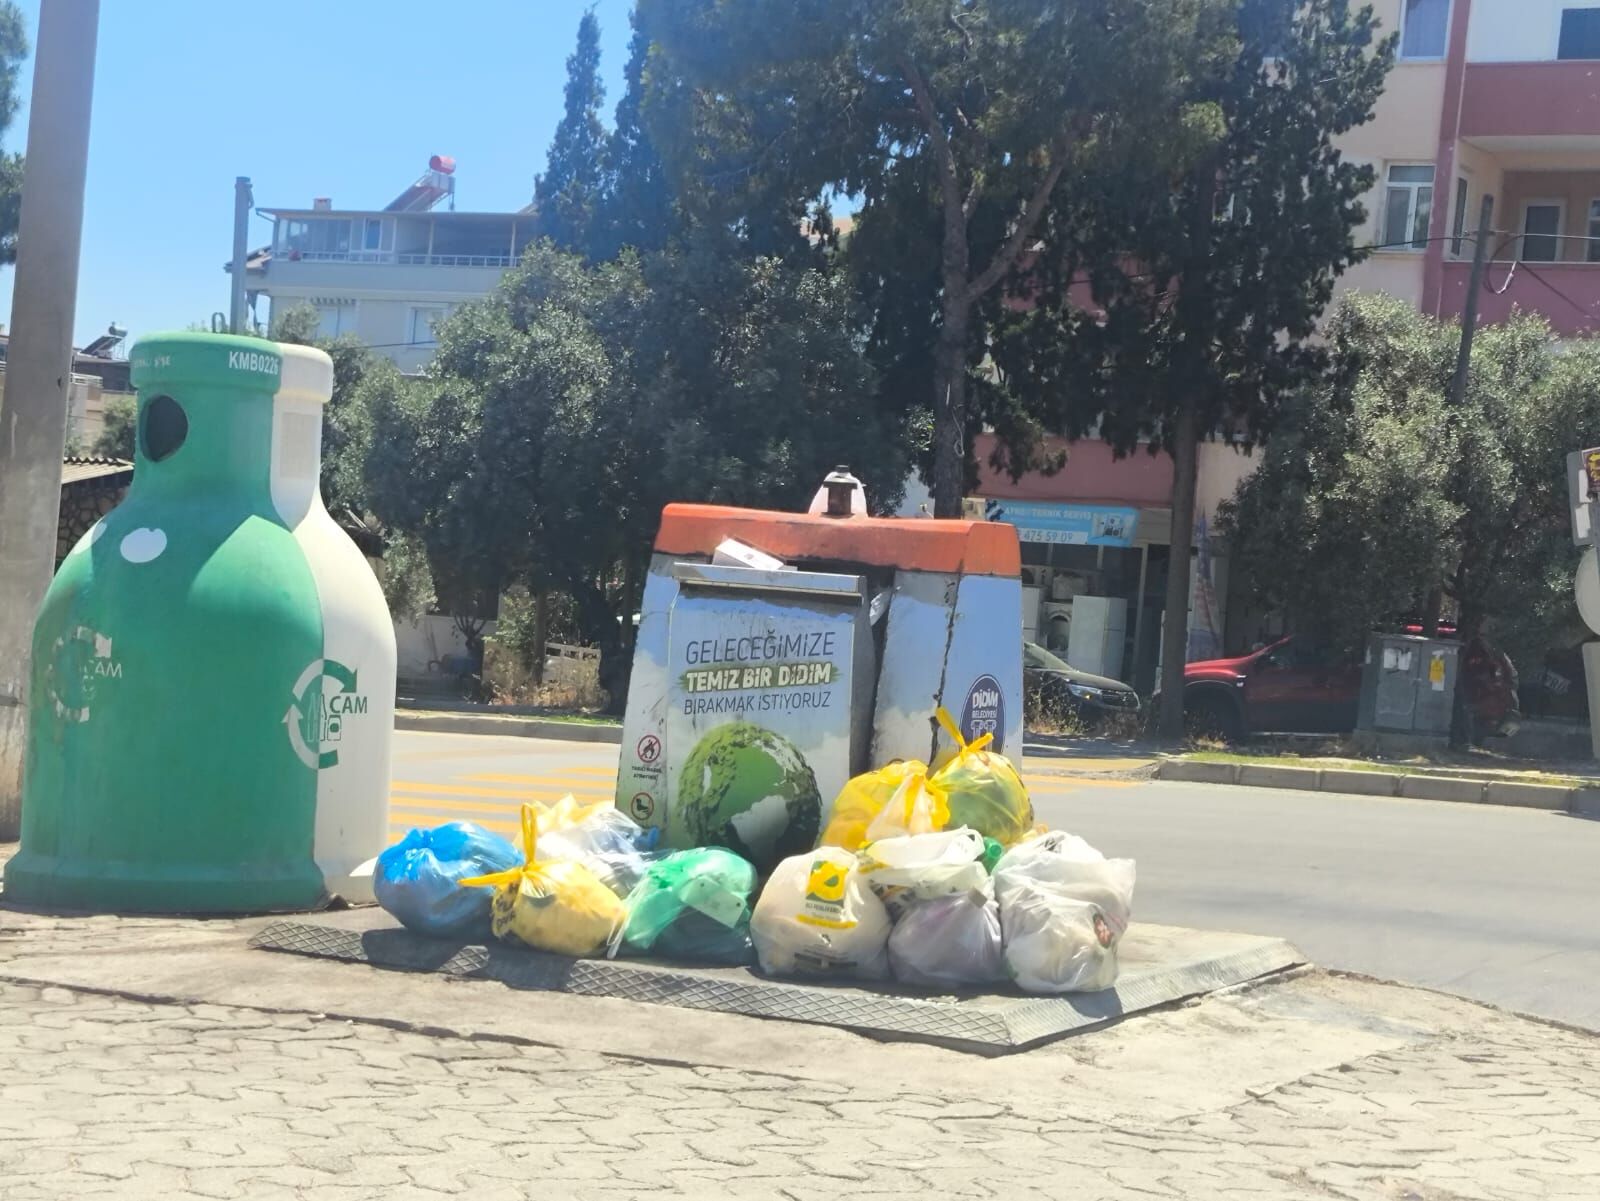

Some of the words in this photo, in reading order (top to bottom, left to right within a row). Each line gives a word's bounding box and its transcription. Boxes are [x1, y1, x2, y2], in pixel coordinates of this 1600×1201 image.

[228, 351, 279, 375] KMB0226
[1046, 531, 1058, 543] 59
[686, 629, 835, 664] GELECEĞİMİZE
[686, 668, 740, 693] TEMİZ
[742, 666, 773, 689] BİR
[777, 662, 832, 686] DİDİM
[329, 695, 368, 714] CAM
[684, 696, 755, 715] BIRAKMAK
[757, 691, 832, 712] İSTİYORUZ
[972, 687, 998, 710] DİDİM
